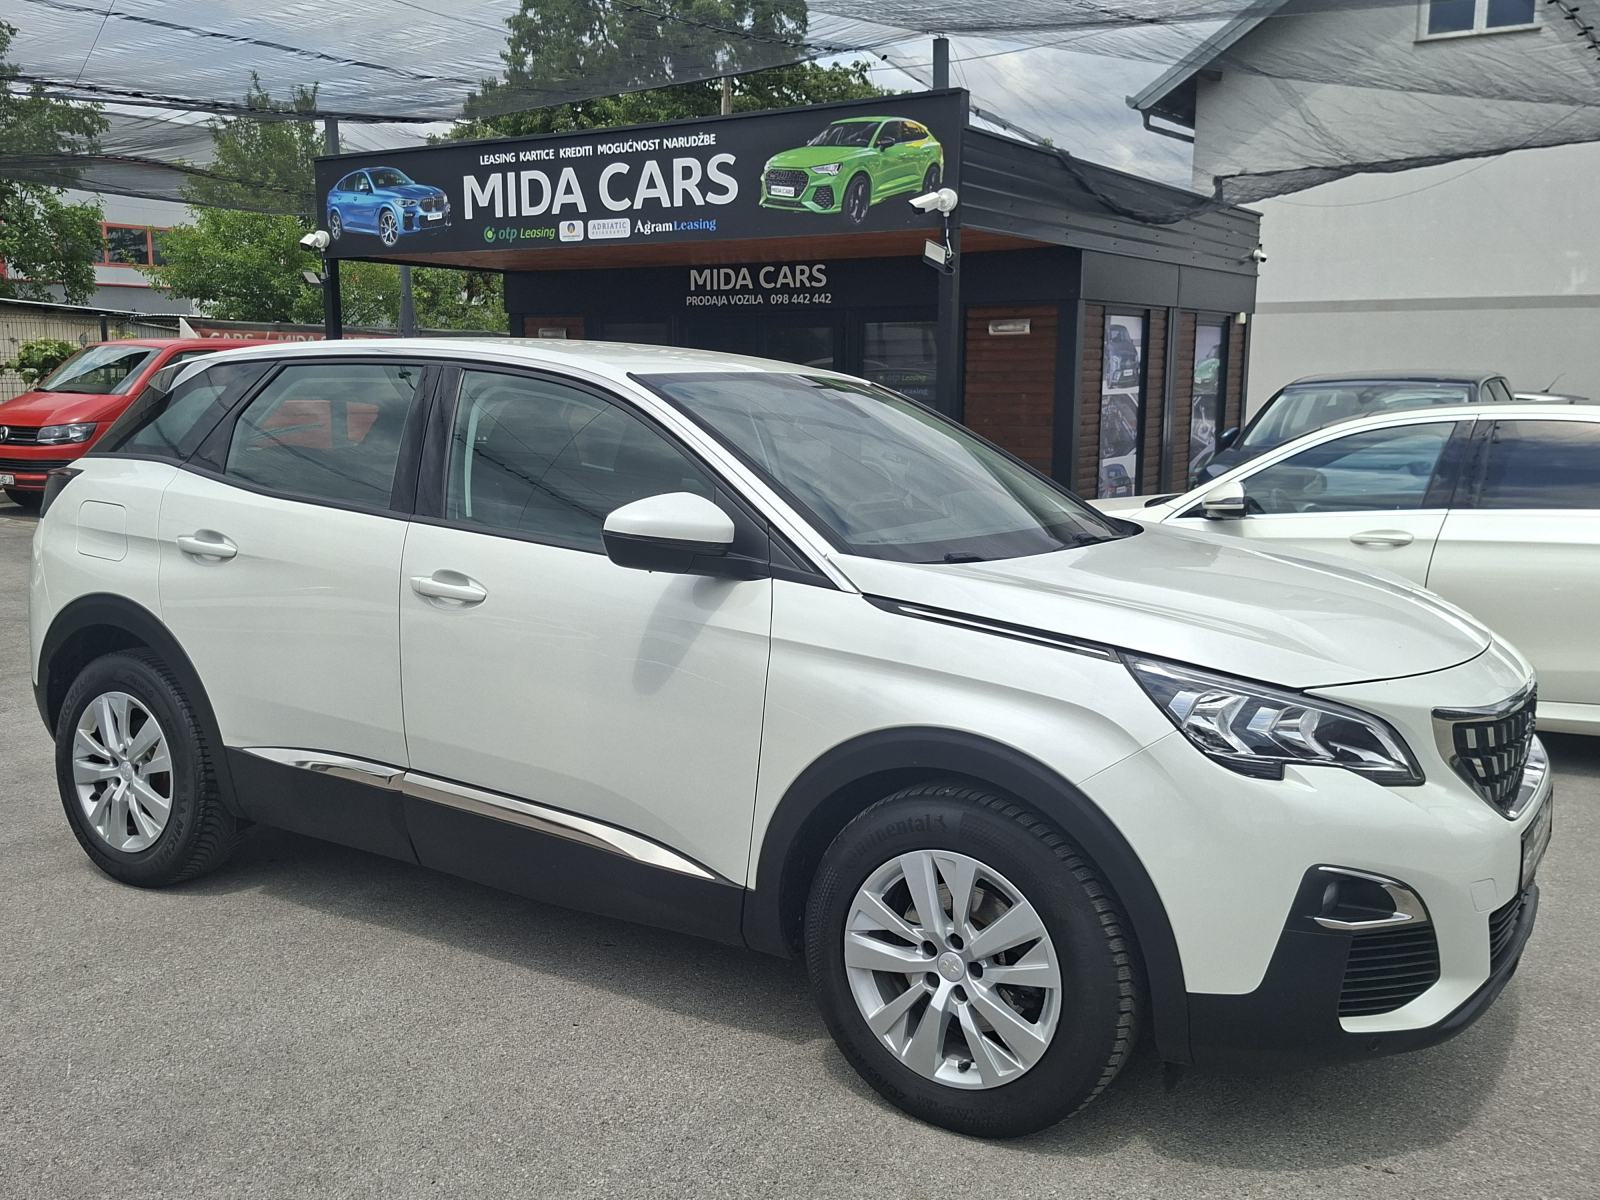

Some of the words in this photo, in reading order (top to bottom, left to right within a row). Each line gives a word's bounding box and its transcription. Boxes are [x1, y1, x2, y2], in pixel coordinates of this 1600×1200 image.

[480, 152, 516, 165] LEASING
[519, 149, 555, 162] KARTICE
[559, 145, 593, 158] KREDITI
[597, 139, 660, 155] MOGUĆNOST
[663, 132, 716, 149] NARUDŽBE
[463, 167, 588, 220] MIDA
[598, 153, 739, 212] CARS
[498, 227, 517, 243] otp
[520, 227, 556, 240] Leasing
[592, 221, 627, 231] ADRIATIC
[690, 267, 754, 291] MIDA
[759, 264, 827, 289] CARS
[686, 295, 728, 307] PRODAJA
[729, 294, 764, 305] VOZILA
[770, 294, 789, 305] 098
[791, 293, 811, 304] 442
[812, 293, 832, 304] 442
